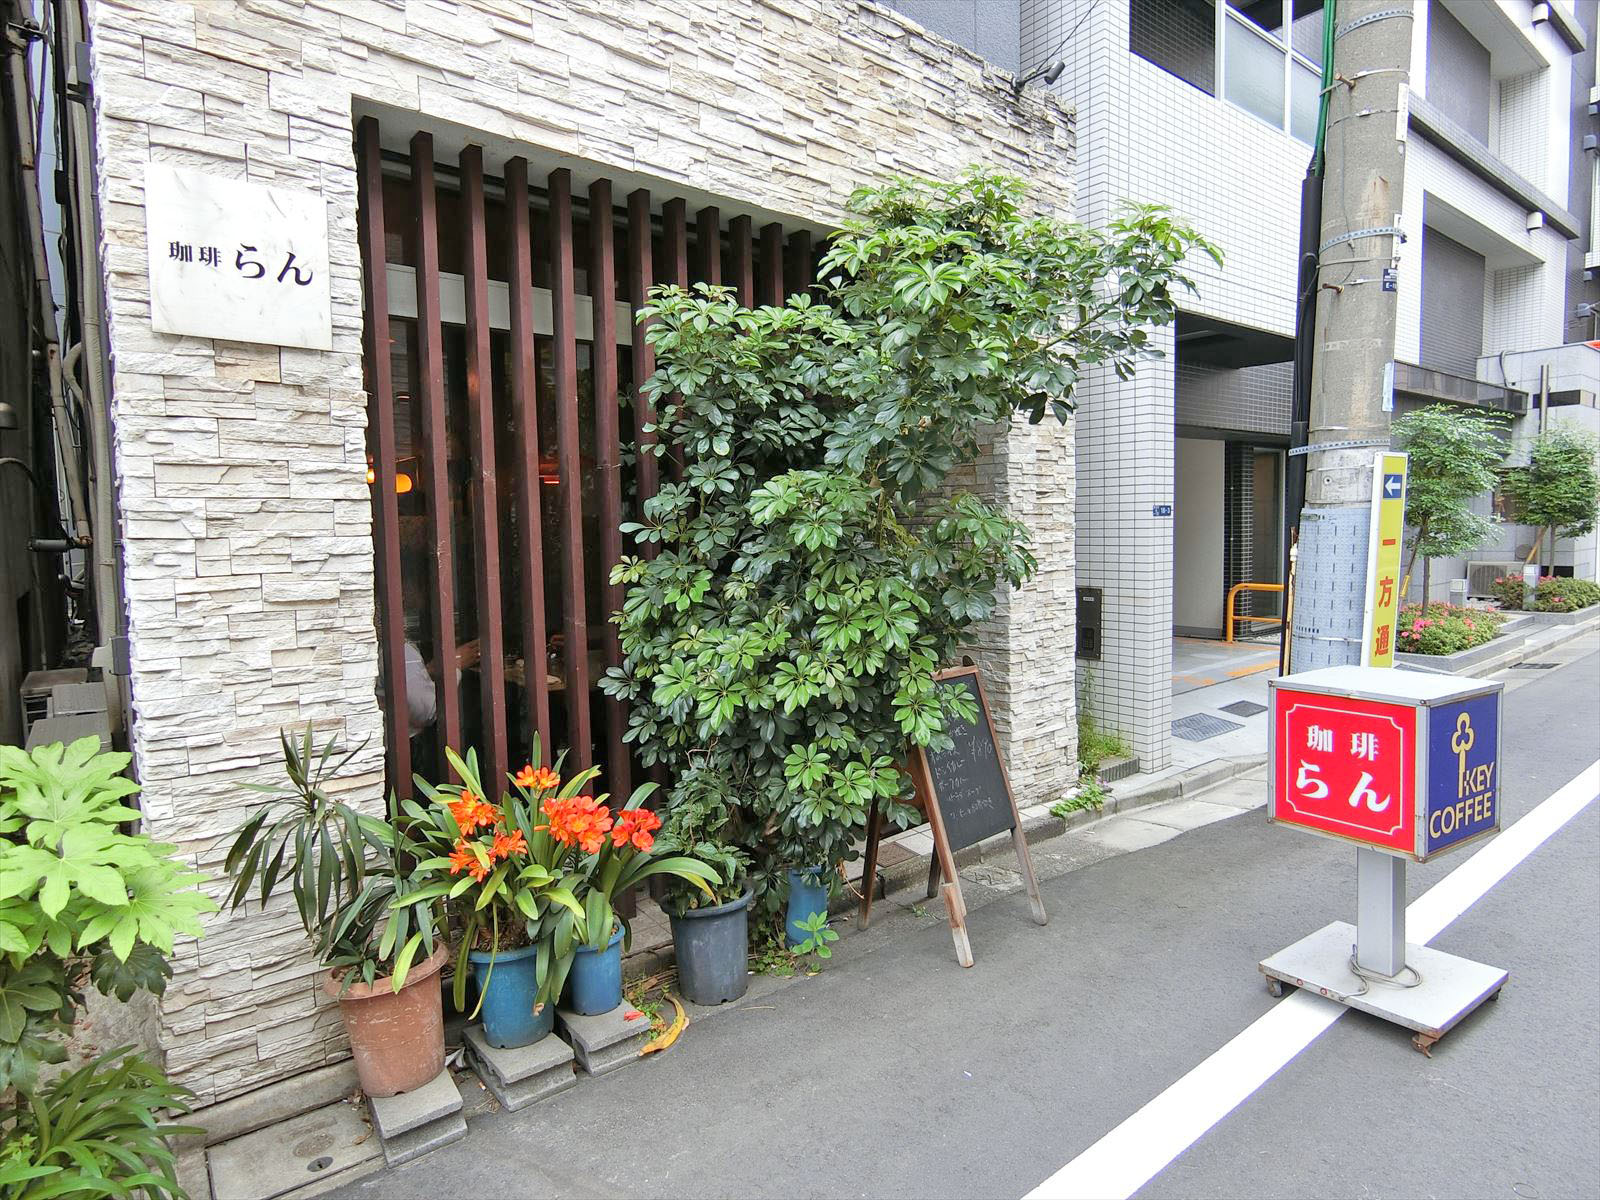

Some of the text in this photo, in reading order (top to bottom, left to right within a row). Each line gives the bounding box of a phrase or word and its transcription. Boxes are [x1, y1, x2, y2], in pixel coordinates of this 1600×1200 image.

[1374, 538, 1396, 657] 一方通
[1306, 724, 1380, 762] 珈琲
[1295, 758, 1391, 813] らん
[1463, 762, 1494, 796] KEY
[1429, 791, 1493, 839] COFFEE
